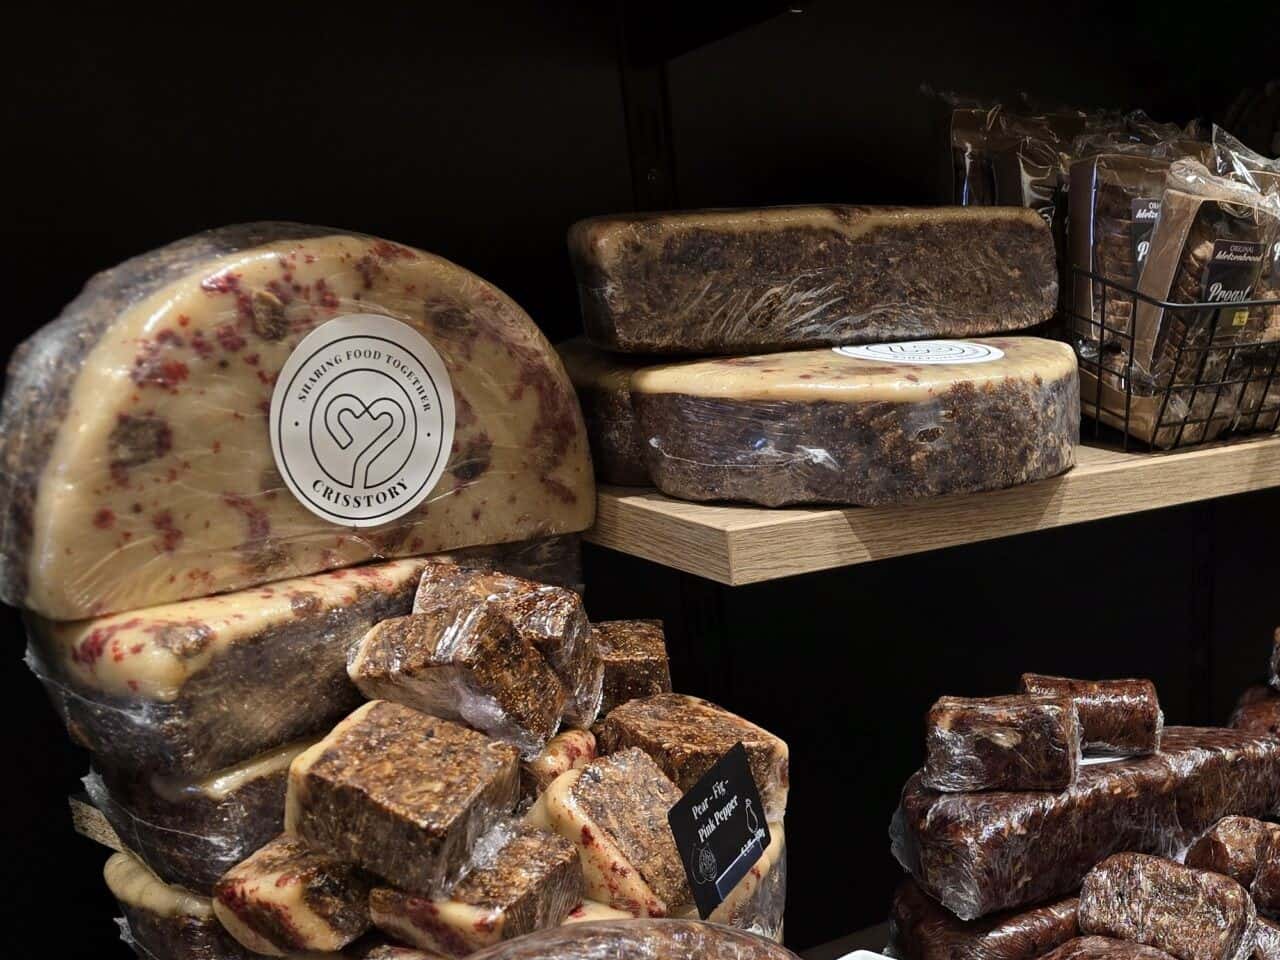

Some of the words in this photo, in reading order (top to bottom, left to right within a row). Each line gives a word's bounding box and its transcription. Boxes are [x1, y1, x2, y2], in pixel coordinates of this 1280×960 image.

[298, 354, 343, 403] SHARING
[346, 349, 382, 361] FOOD
[385, 353, 432, 412] TOGETHER
[311, 478, 409, 509] CRISSTORY
[691, 797, 709, 821] Pear
[712, 781, 727, 798] Fig
[698, 818, 717, 843] Pink
[714, 795, 738, 825] Pepper
